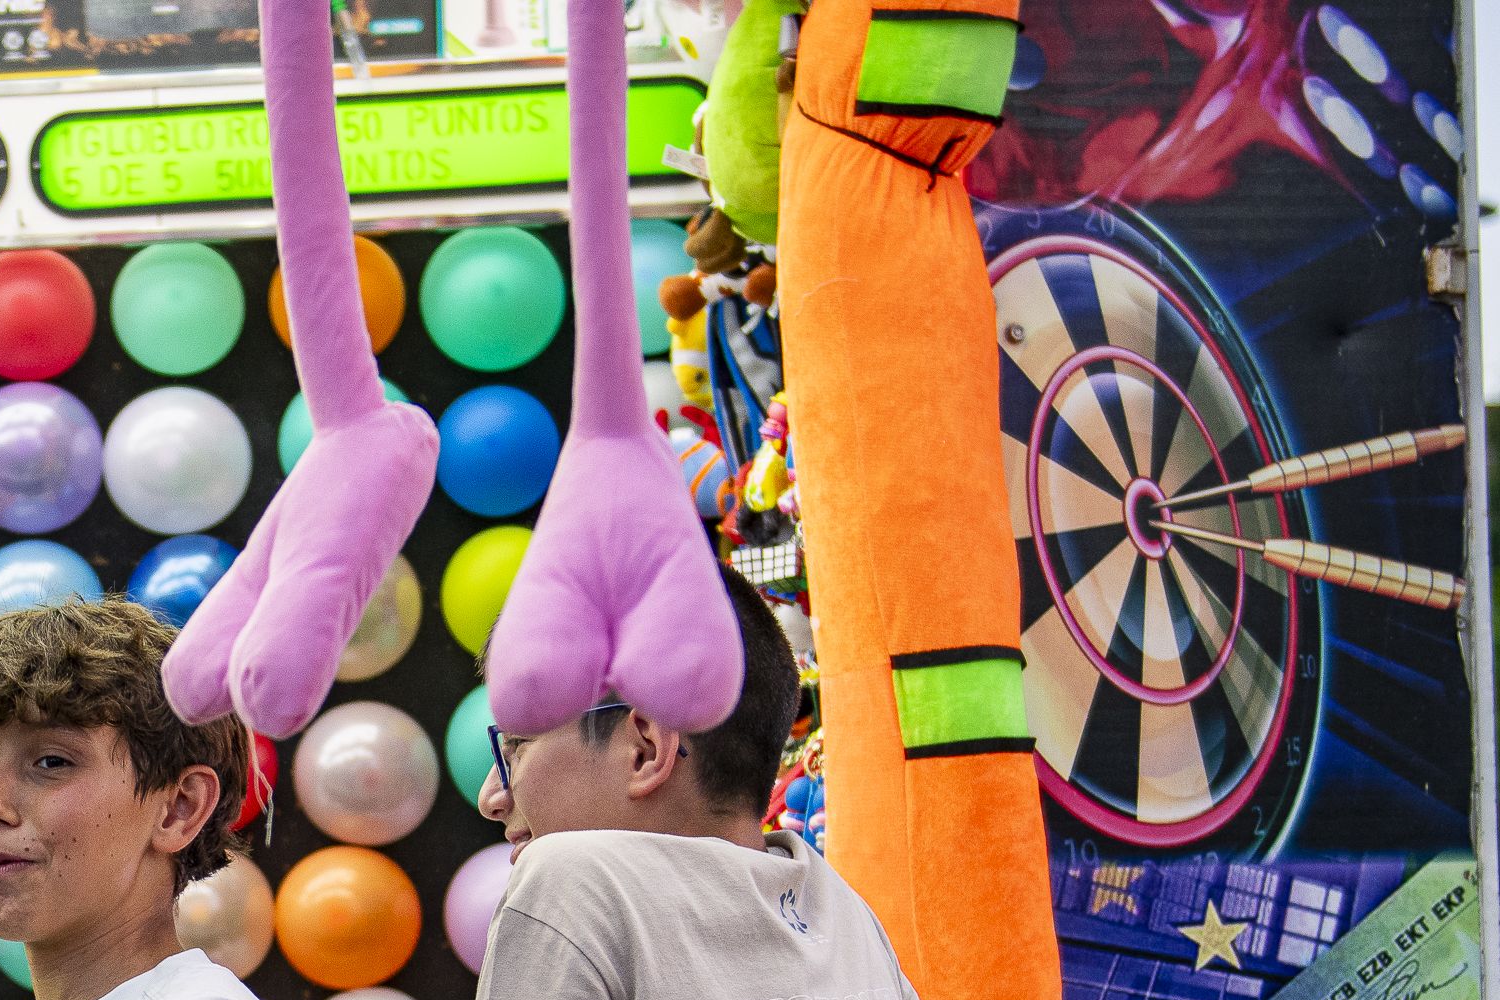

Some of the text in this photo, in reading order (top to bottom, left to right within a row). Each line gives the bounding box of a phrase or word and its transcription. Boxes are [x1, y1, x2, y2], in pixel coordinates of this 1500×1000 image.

[79, 120, 214, 157] GLOBLO
[225, 115, 271, 148] RO
[406, 100, 549, 139] PUNTOS
[62, 166, 83, 198] 5
[101, 162, 146, 196] DE
[163, 161, 184, 193] 5
[1357, 949, 1394, 986] EZB
[1394, 915, 1431, 953] EKT
[1431, 885, 1467, 921] EKP
